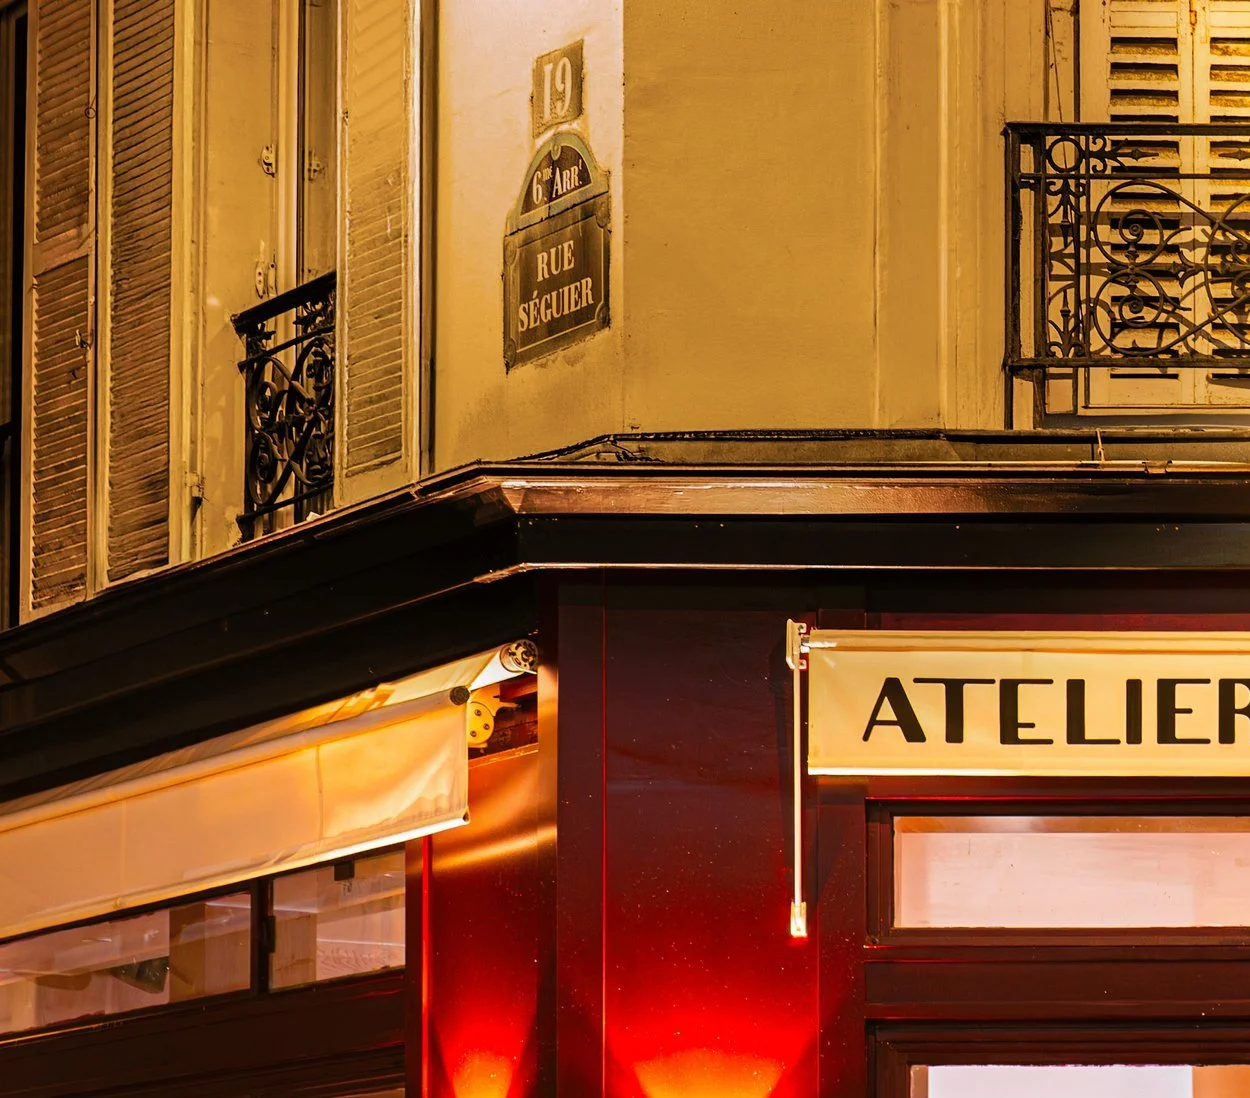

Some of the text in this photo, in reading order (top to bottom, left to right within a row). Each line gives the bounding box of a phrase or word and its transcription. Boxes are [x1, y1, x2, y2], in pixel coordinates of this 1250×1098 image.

[543, 56, 573, 121] 19
[536, 240, 575, 282] RUE
[518, 277, 594, 333] SÉGUIER
